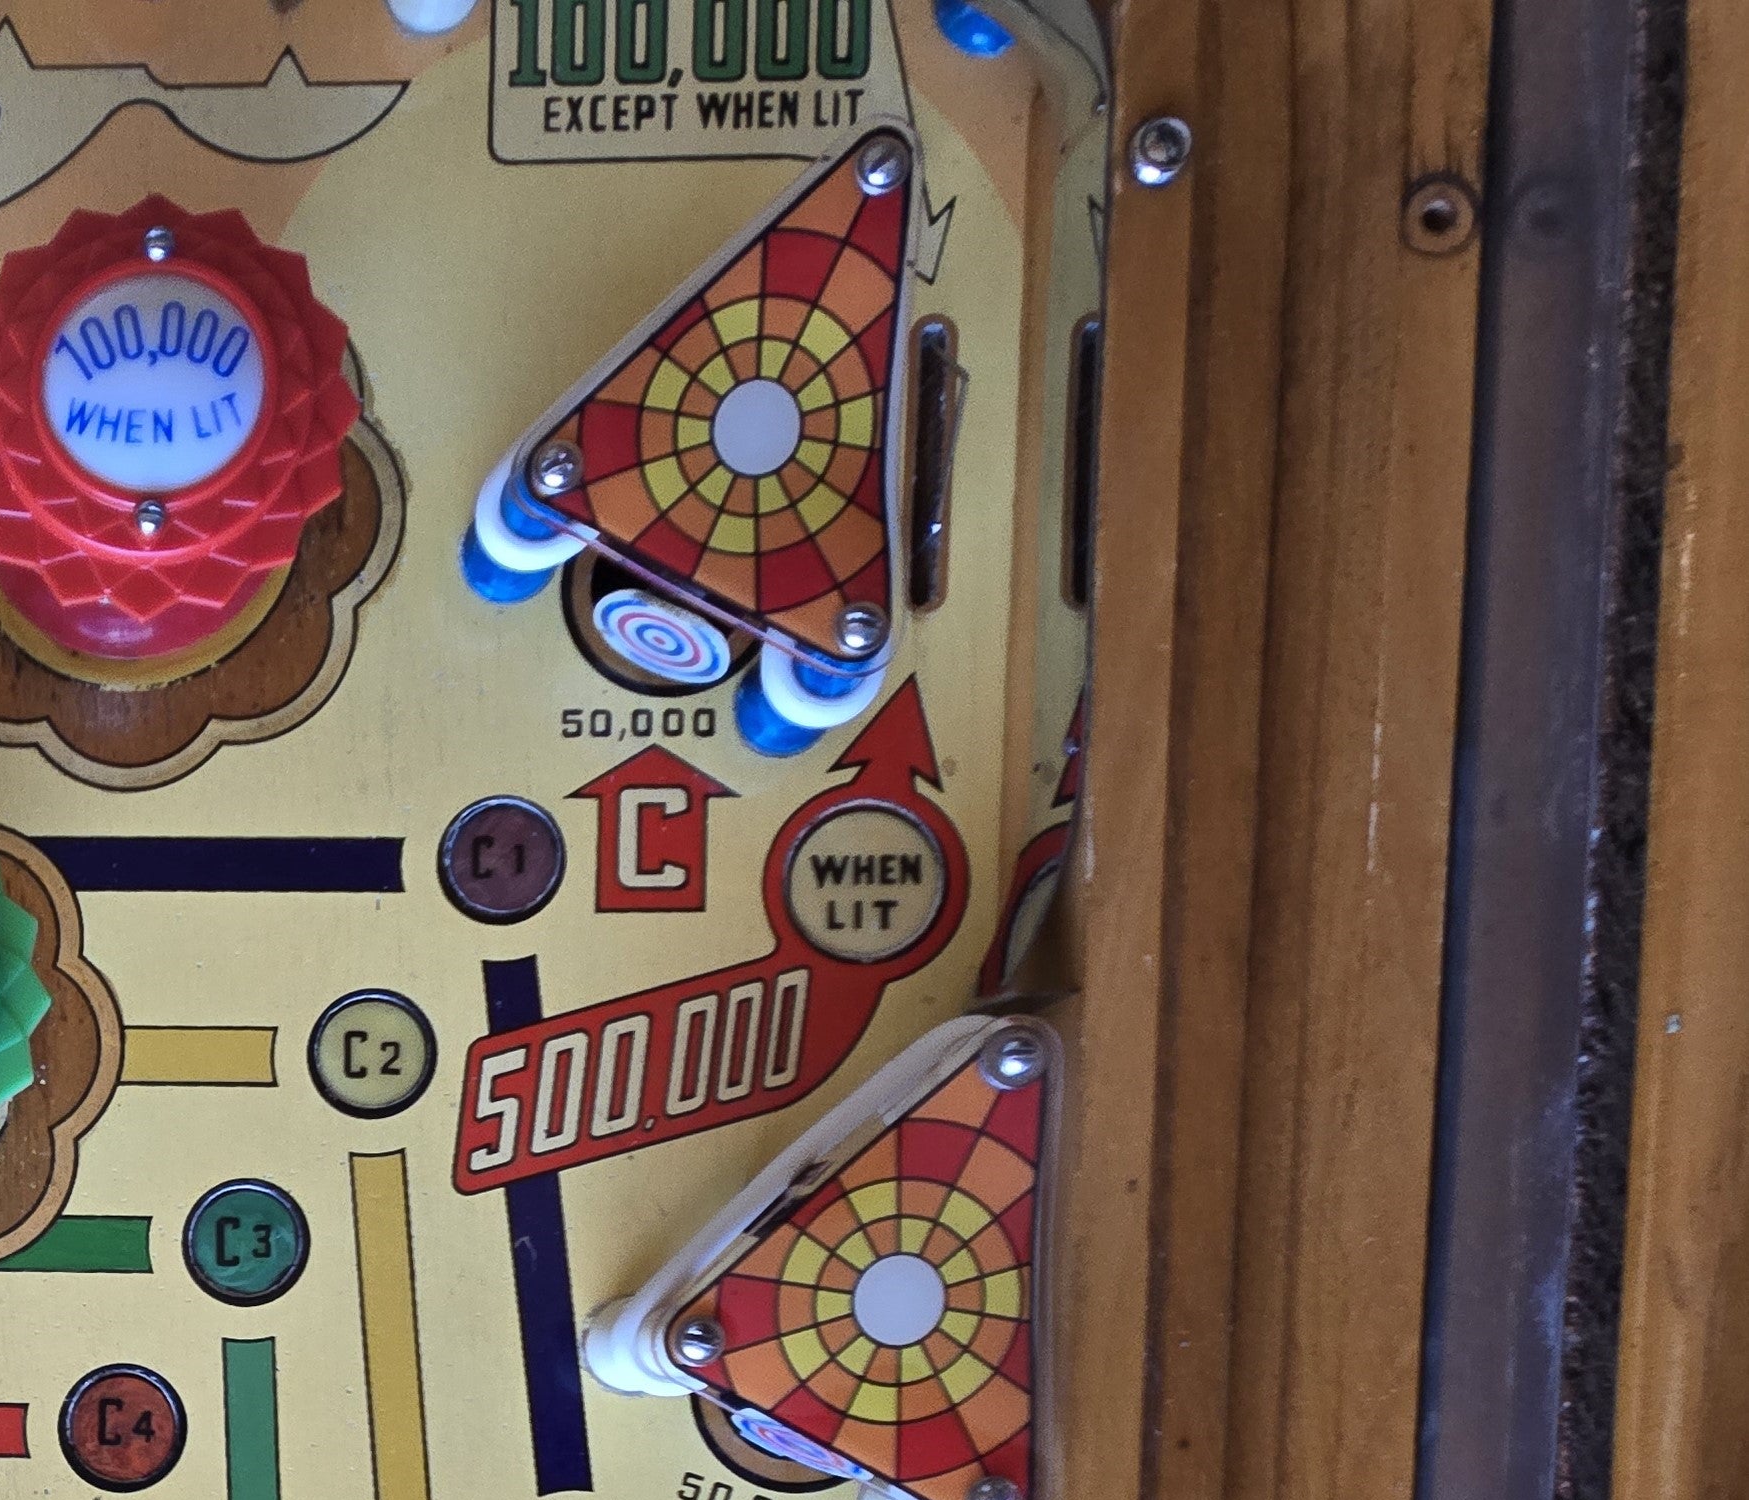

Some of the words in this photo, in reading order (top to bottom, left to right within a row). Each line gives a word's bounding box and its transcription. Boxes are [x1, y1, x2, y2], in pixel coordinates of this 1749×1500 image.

[508, 0, 870, 88] 100,000
[544, 93, 679, 133] EXCEPT
[696, 90, 799, 130] WHEN
[814, 88, 864, 127] LIT
[55, 300, 250, 381] 100,000
[66, 397, 173, 443] WHEN
[190, 392, 242, 438] LIT
[562, 708, 717, 742] 50,000
[618, 787, 688, 889] C
[811, 853, 922, 887] WHEN
[828, 900, 899, 932] LIT
[469, 968, 809, 1171] 500,000
